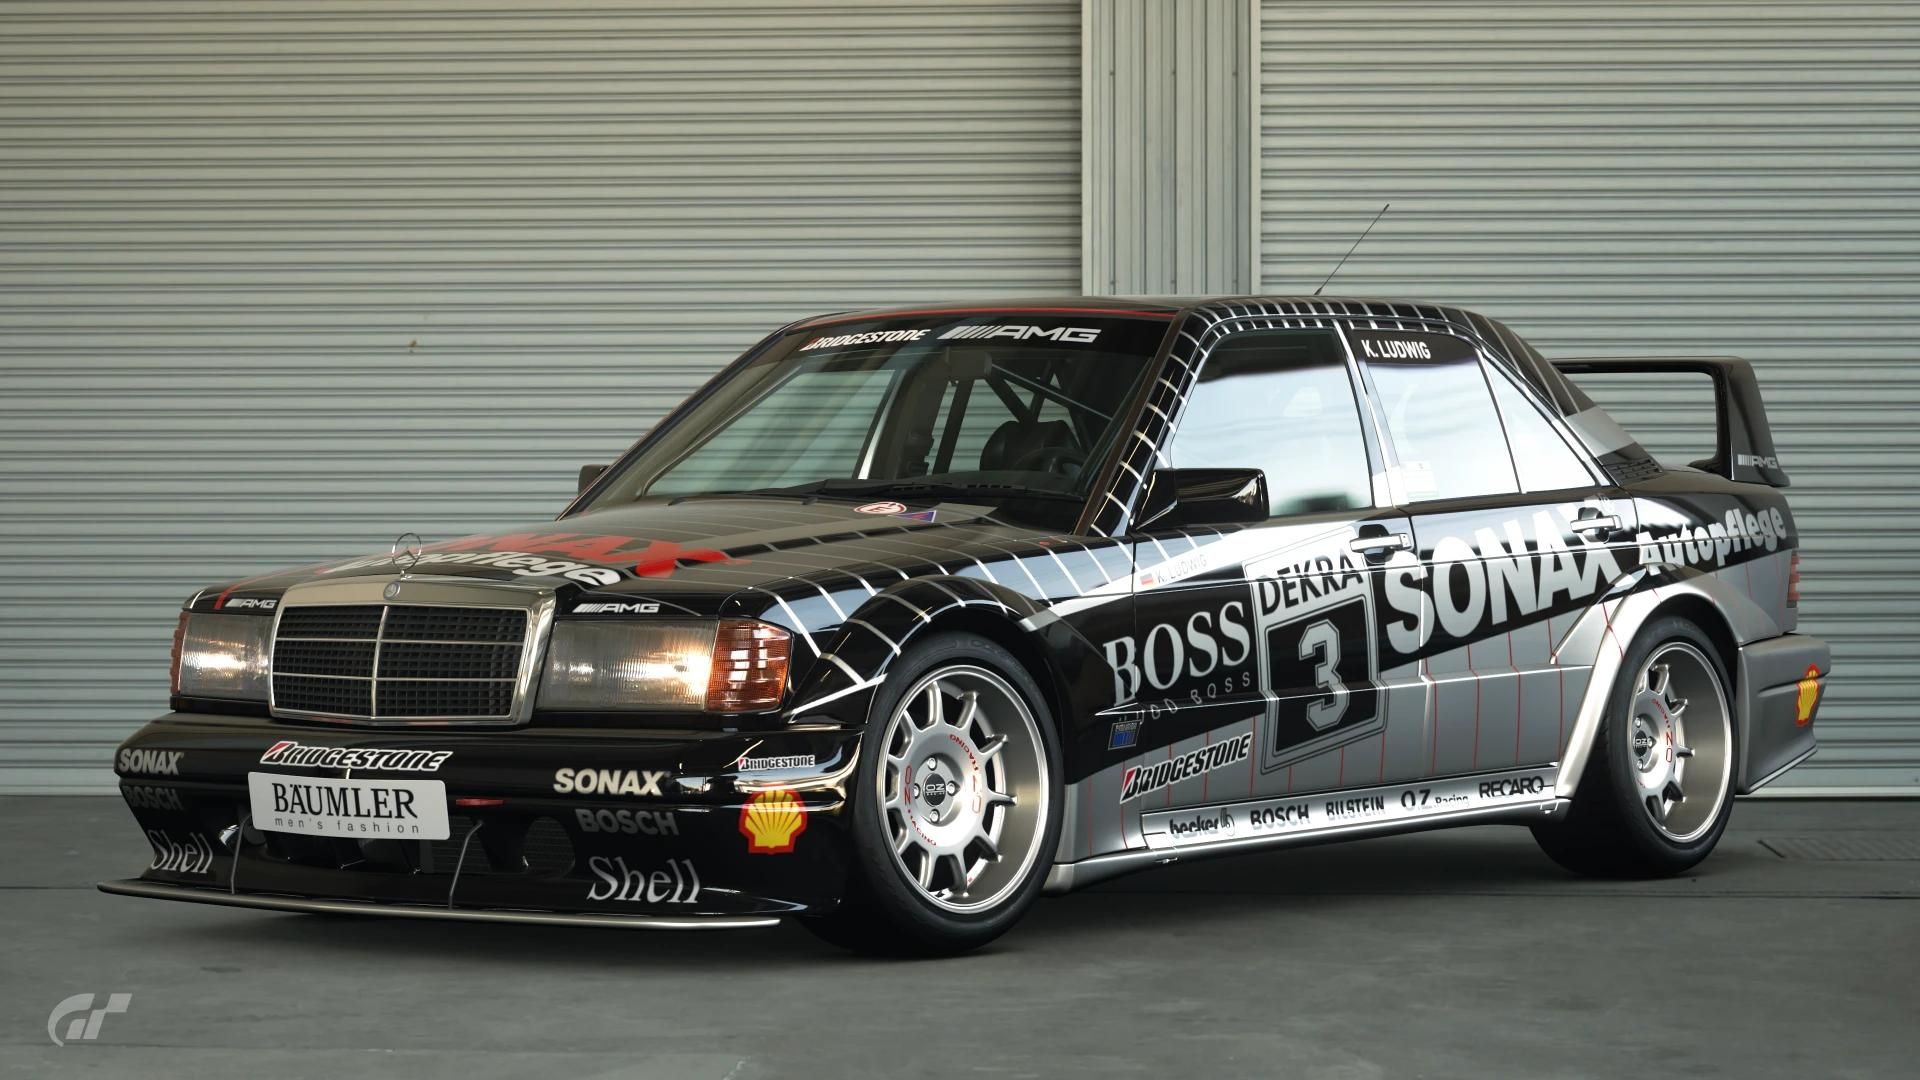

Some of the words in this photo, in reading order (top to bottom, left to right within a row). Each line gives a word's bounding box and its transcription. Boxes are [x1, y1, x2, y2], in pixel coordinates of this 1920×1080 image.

[799, 329, 932, 352] BRIDGESTONE
[985, 325, 1102, 343] AMG
[1361, 340, 1379, 357] K.
[1381, 340, 1432, 360] LUDWIG
[1751, 455, 1778, 469] AMG
[1637, 505, 1787, 576] Autopflege
[323, 551, 622, 586] opflege
[1256, 548, 1364, 617] DEKRA
[1384, 494, 1624, 655] SONAX
[238, 599, 278, 610] AMG
[601, 603, 661, 614] AMG
[1103, 601, 1251, 708] BOSS
[1299, 619, 1350, 732] 3
[118, 748, 181, 776] SONAX
[260, 740, 453, 771] BRIDGESTONE
[738, 755, 815, 771] BRIDGESTONE
[1120, 732, 1254, 804] BRIDGESTONE
[553, 767, 664, 797] SONAX
[271, 782, 418, 819] BÄUMLER
[1169, 815, 1219, 838] becker
[1250, 803, 1310, 830] BOSCH
[1326, 795, 1386, 821] BILSTEIN
[1479, 776, 1544, 799] RECARO
[274, 817, 324, 831] men's
[337, 820, 419, 834] fashion
[576, 808, 680, 837] BOSCH
[147, 829, 213, 874] Shell
[586, 856, 701, 904] Shell
